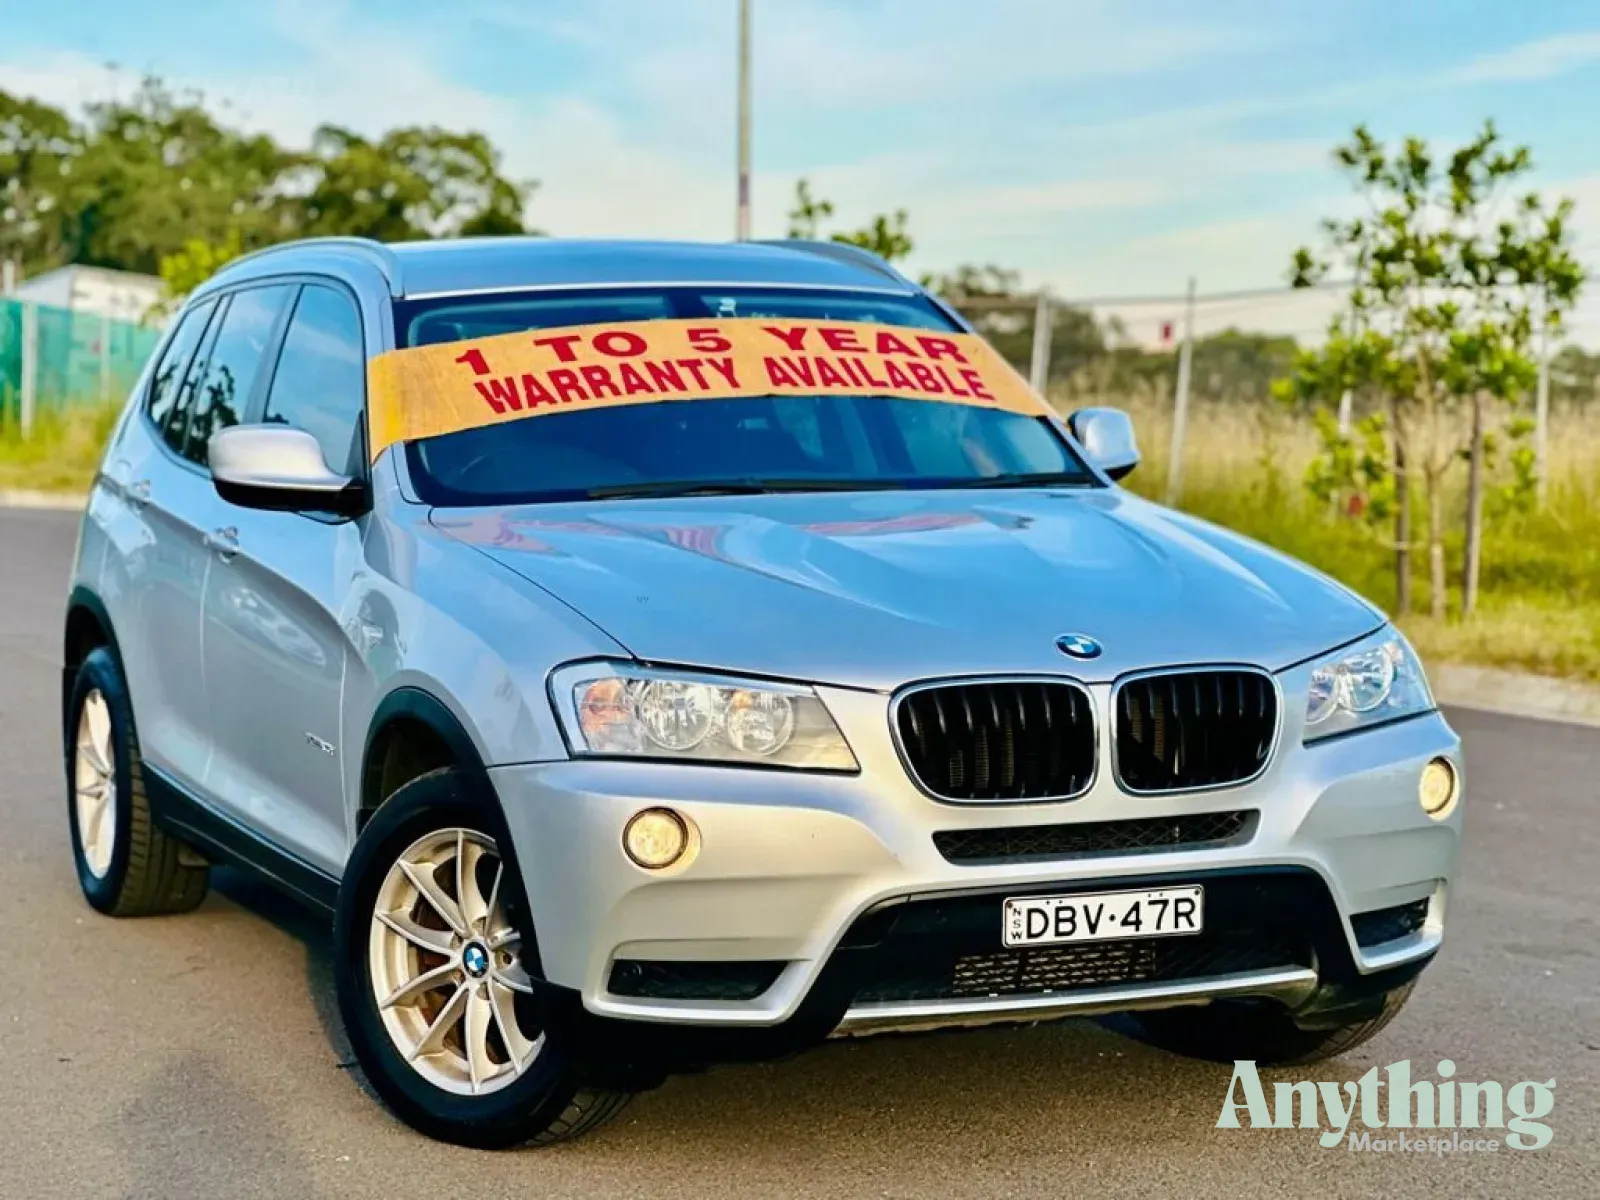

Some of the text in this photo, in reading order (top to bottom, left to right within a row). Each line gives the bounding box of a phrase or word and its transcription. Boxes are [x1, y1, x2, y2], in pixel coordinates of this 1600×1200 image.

[455, 327, 968, 376] 1 TO 5 YEAR
[474, 356, 996, 415] WARRANTY AVAILABLE
